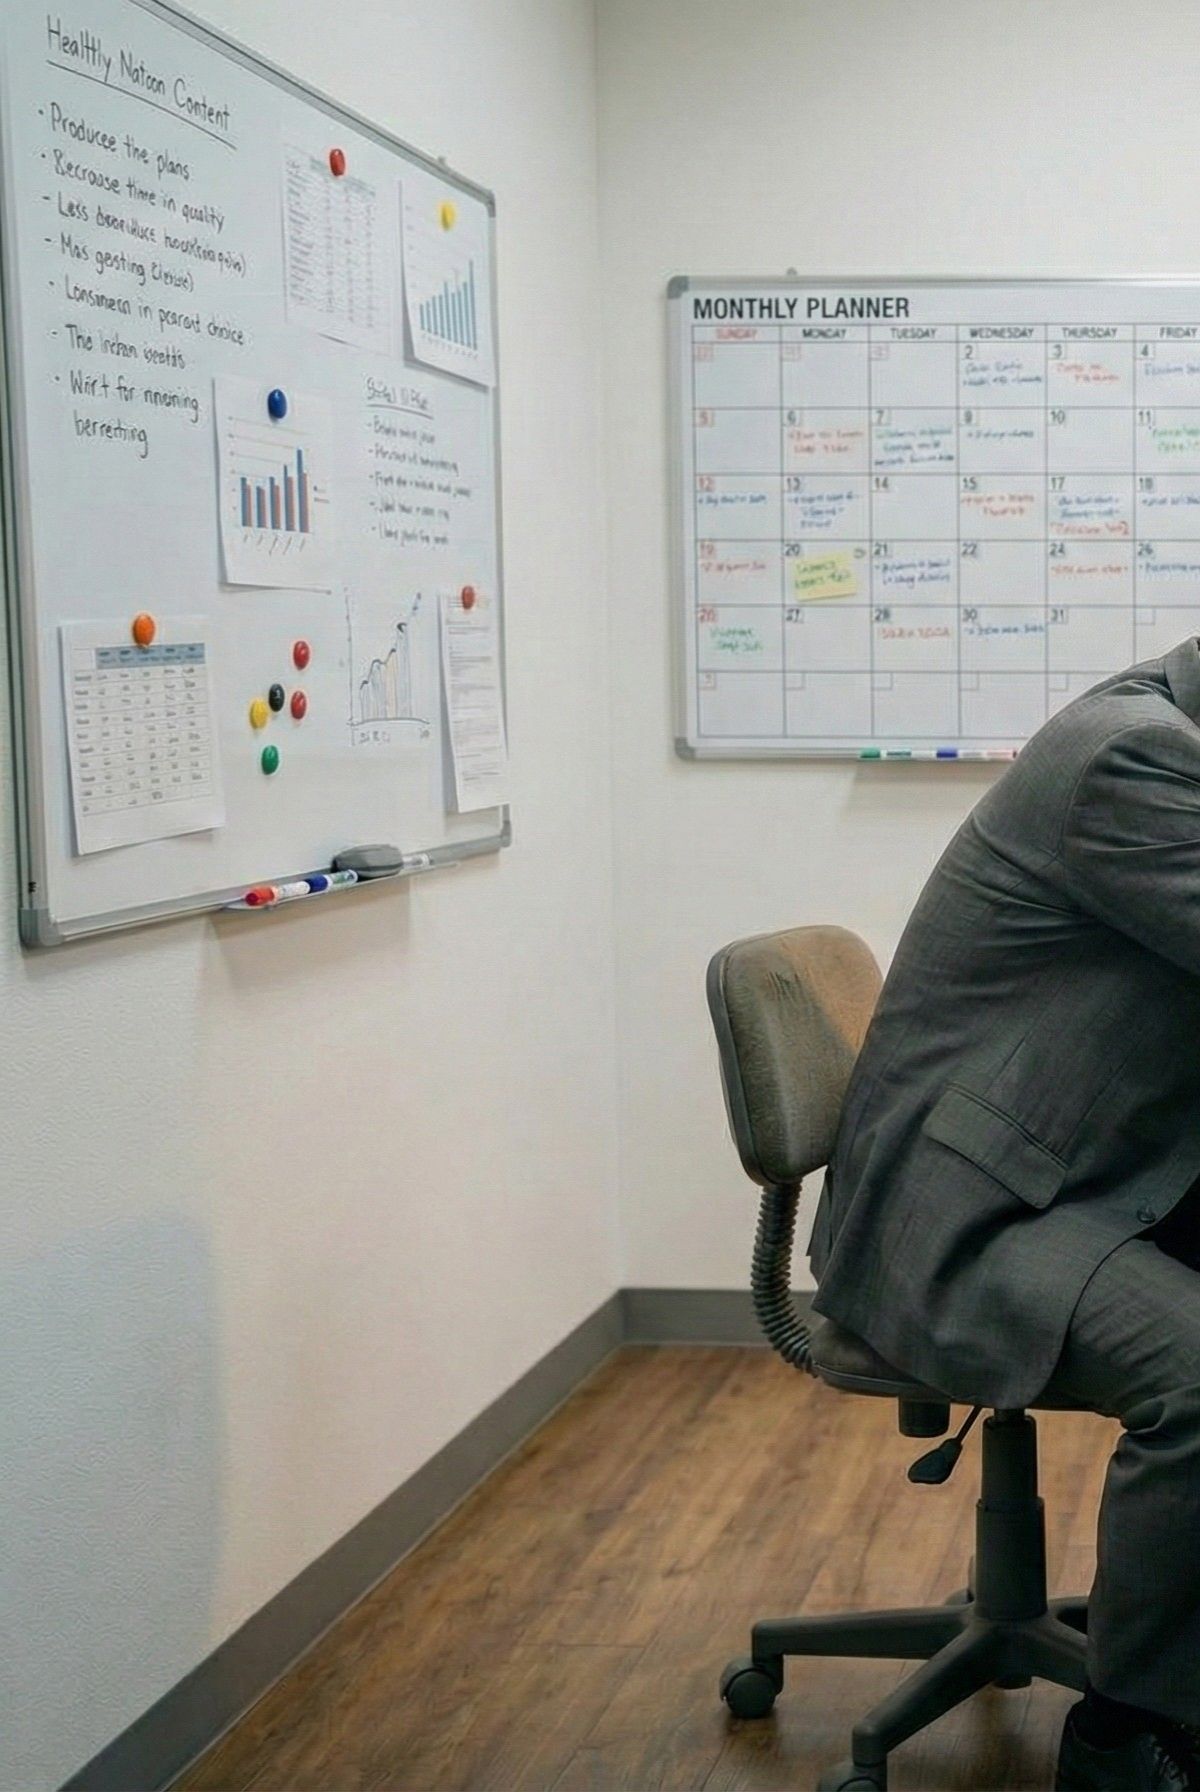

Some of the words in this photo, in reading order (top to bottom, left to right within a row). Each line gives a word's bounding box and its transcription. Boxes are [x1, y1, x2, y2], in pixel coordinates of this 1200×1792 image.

[174, 78, 230, 131] Content
[157, 149, 190, 180] plans
[162, 190, 176, 212] in
[138, 297, 153, 321] in
[693, 298, 798, 319] MONTHLY
[807, 297, 909, 318] PLANNER
[803, 328, 846, 339] MONDAY
[890, 328, 937, 339] TUESDAY
[970, 328, 1034, 339] WEDNESDAY
[1062, 327, 1117, 338] THURSDAY
[1160, 327, 1197, 338] FRIDAY
[964, 345, 973, 359] 2
[1053, 344, 1062, 359] 3
[1141, 344, 1149, 357] 4
[787, 410, 796, 424] 6
[875, 410, 884, 424] 7
[1050, 410, 1066, 424] 10
[1138, 410, 1151, 424] 11
[874, 477, 889, 490] 14
[963, 477, 977, 490] 15
[1051, 477, 1065, 491] 17
[785, 543, 800, 557] 20
[874, 543, 888, 556] 21
[962, 543, 977, 557] 22
